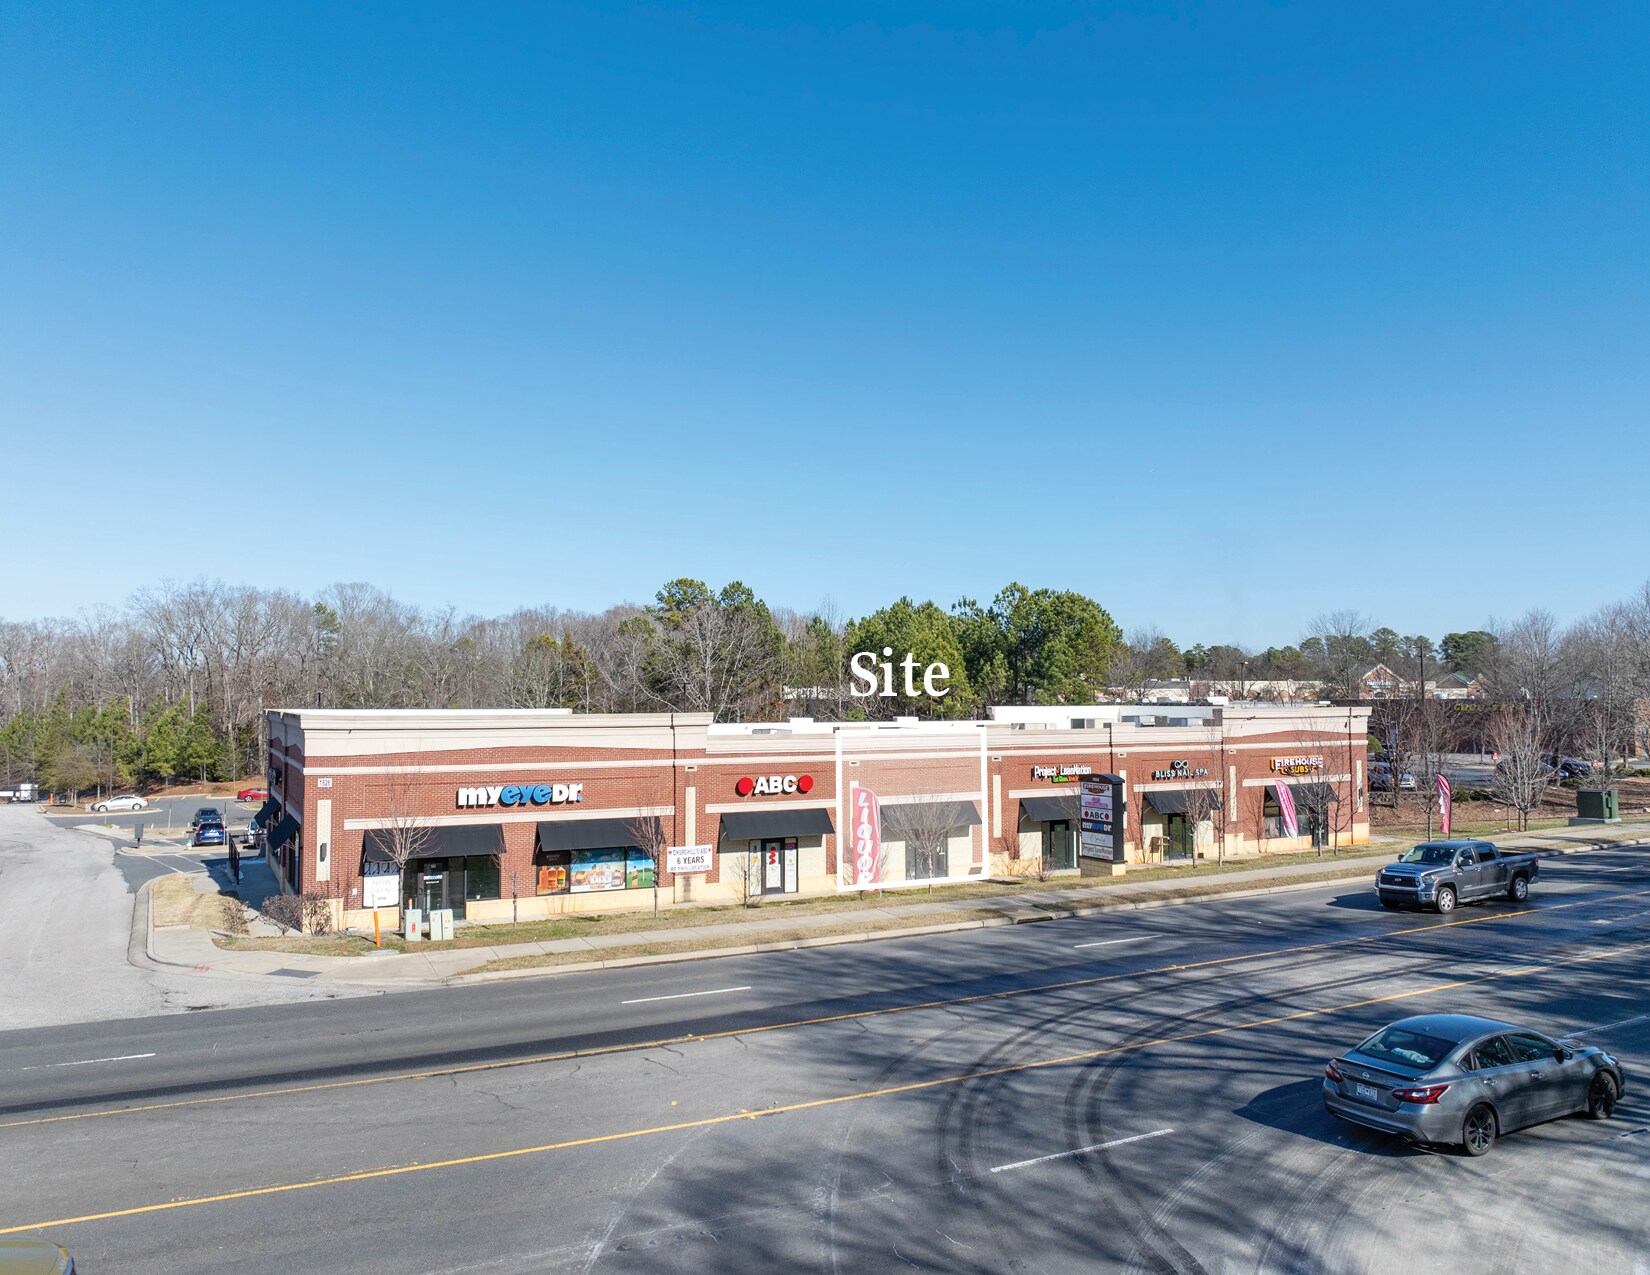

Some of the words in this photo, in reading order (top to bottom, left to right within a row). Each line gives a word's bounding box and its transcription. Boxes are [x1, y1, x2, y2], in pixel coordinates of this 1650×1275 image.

[1275, 757, 1323, 771] FIREHOUSE
[1291, 765, 1309, 773] SUBS
[1155, 770, 1175, 778] BLISS
[1195, 768, 1208, 776] SPA
[753, 775, 798, 794] ABC
[857, 792, 873, 886] LIQUOR
[677, 857, 681, 865] 6
[683, 856, 704, 864] YEARS
